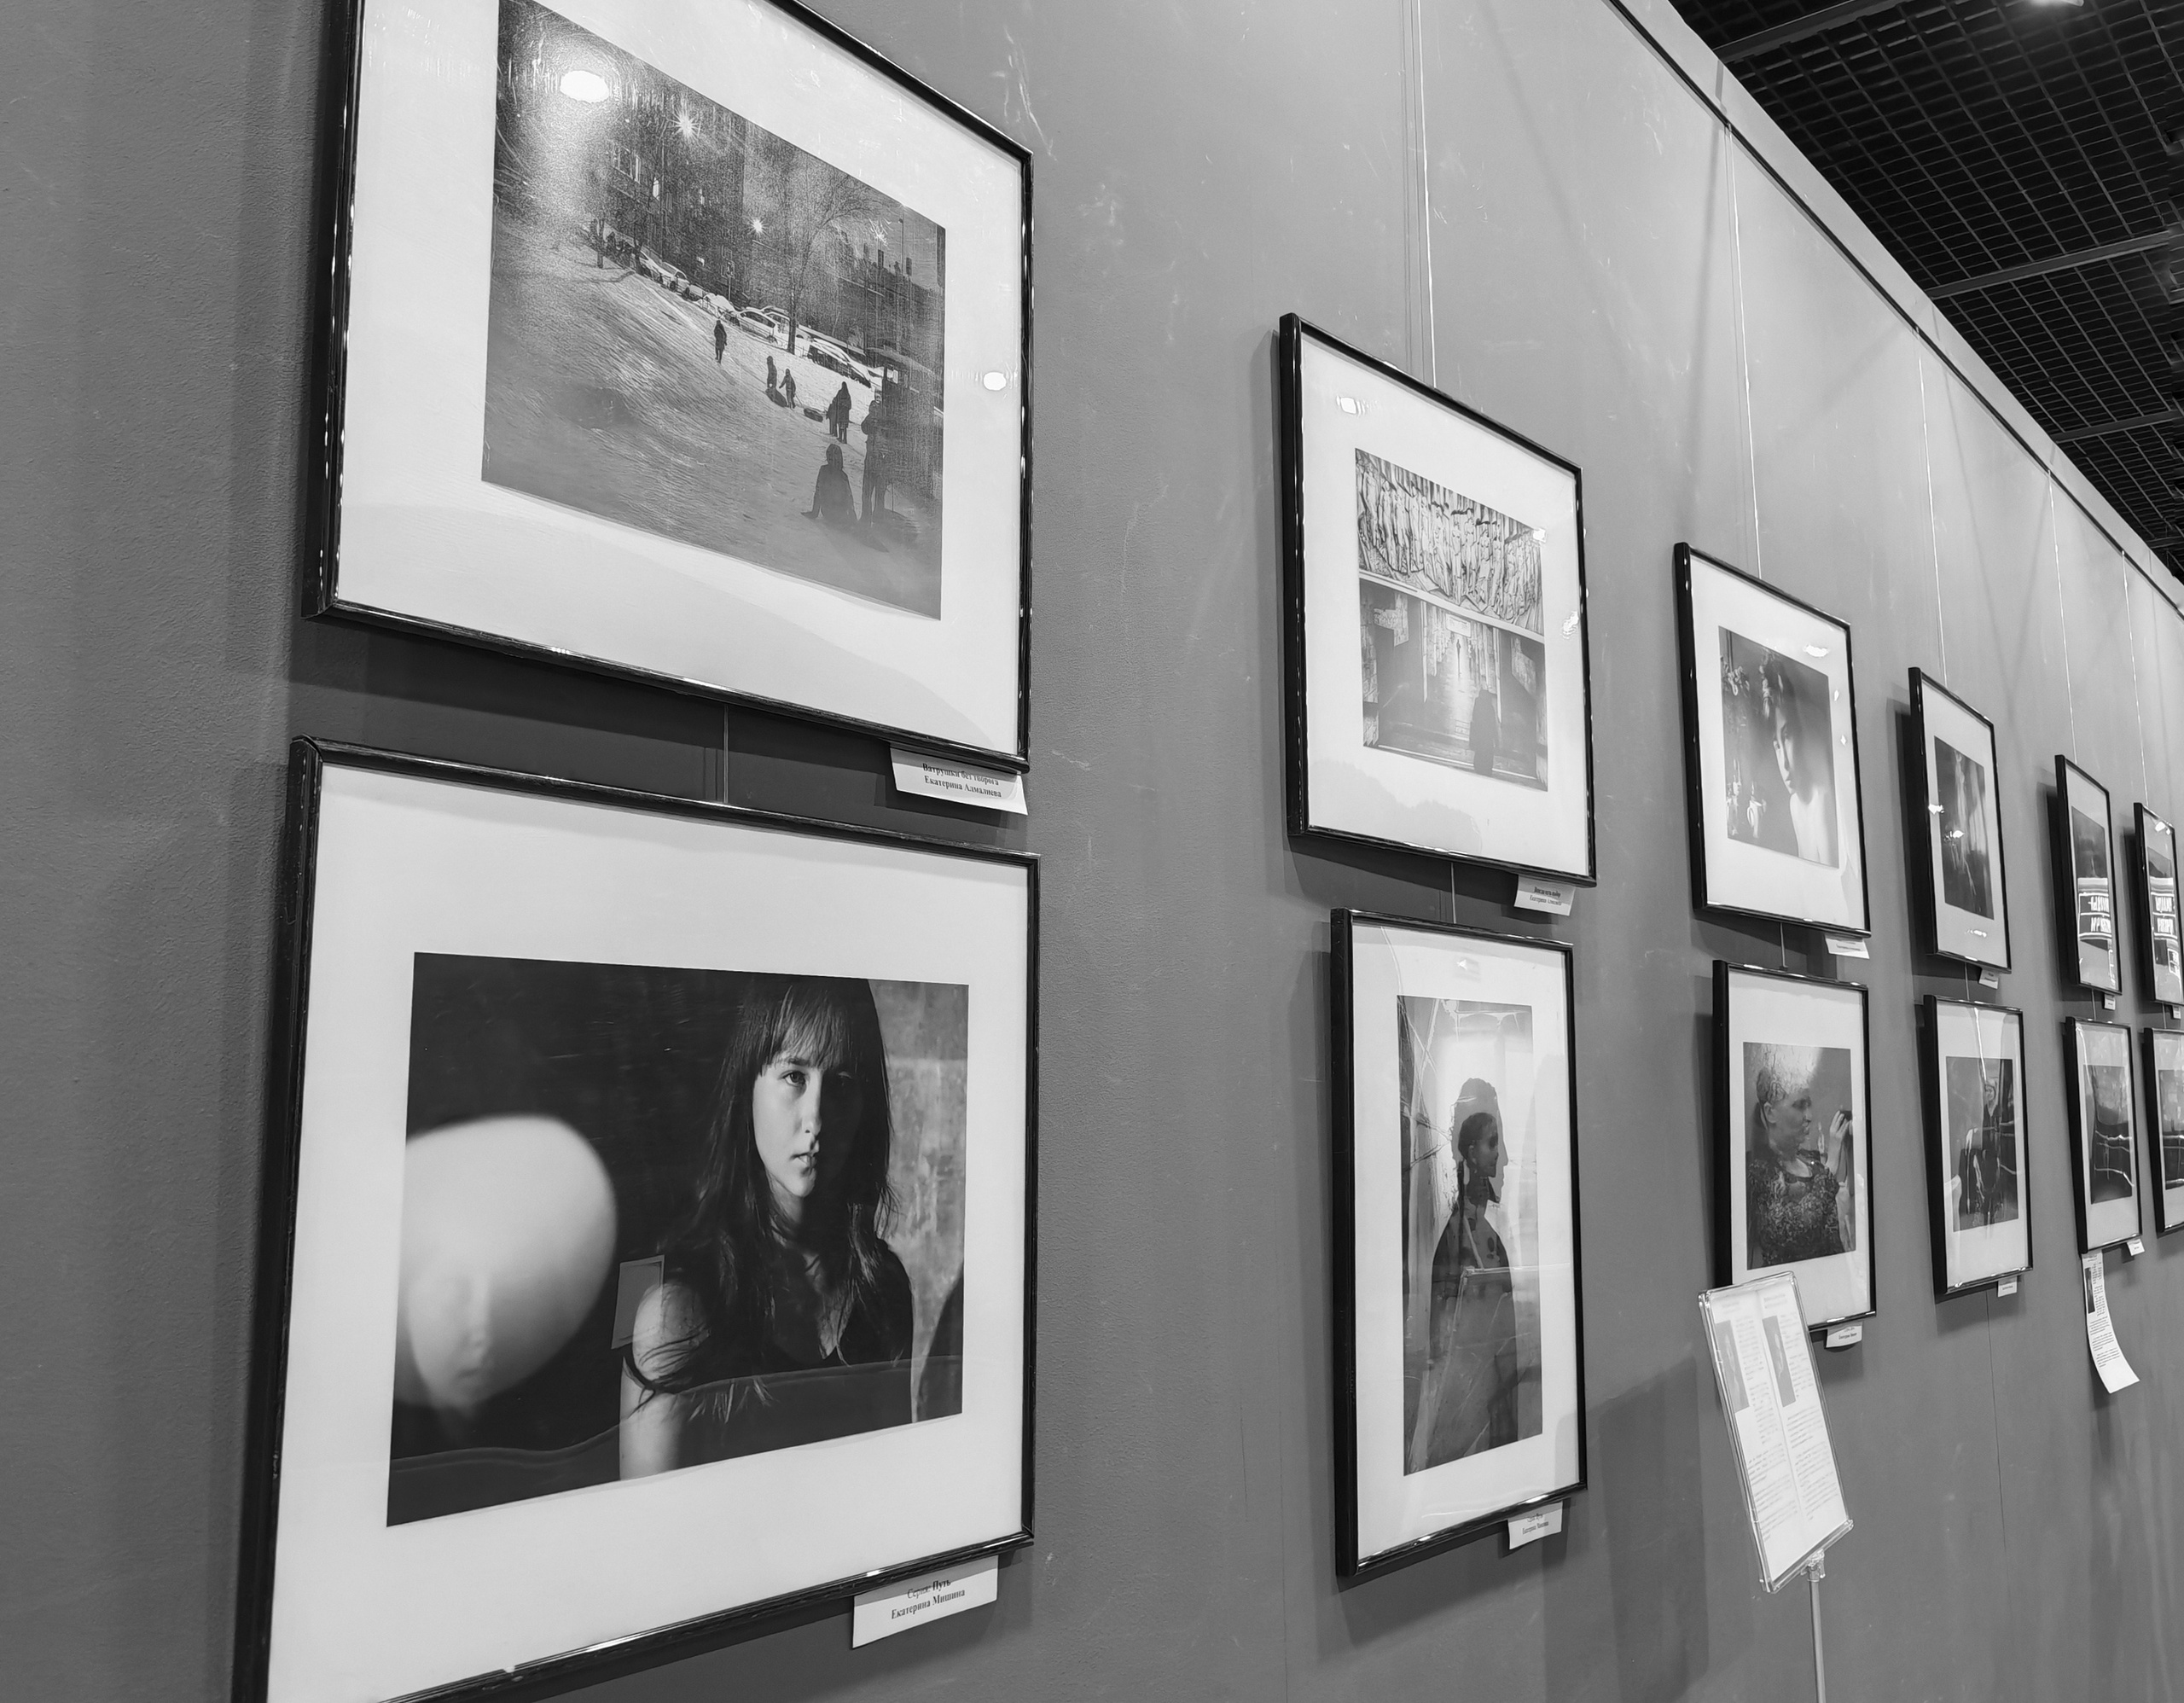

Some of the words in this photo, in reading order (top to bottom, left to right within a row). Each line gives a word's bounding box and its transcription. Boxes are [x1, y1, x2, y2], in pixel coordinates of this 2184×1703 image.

[922, 763, 960, 777] Ватрушки
[961, 770, 972, 780] без
[973, 775, 999, 786] творога
[924, 775, 962, 790] Екатерина
[932, 1580, 951, 1591] Путь
[892, 1600, 931, 1619] Екатерина
[932, 1590, 965, 1605] Мишина
